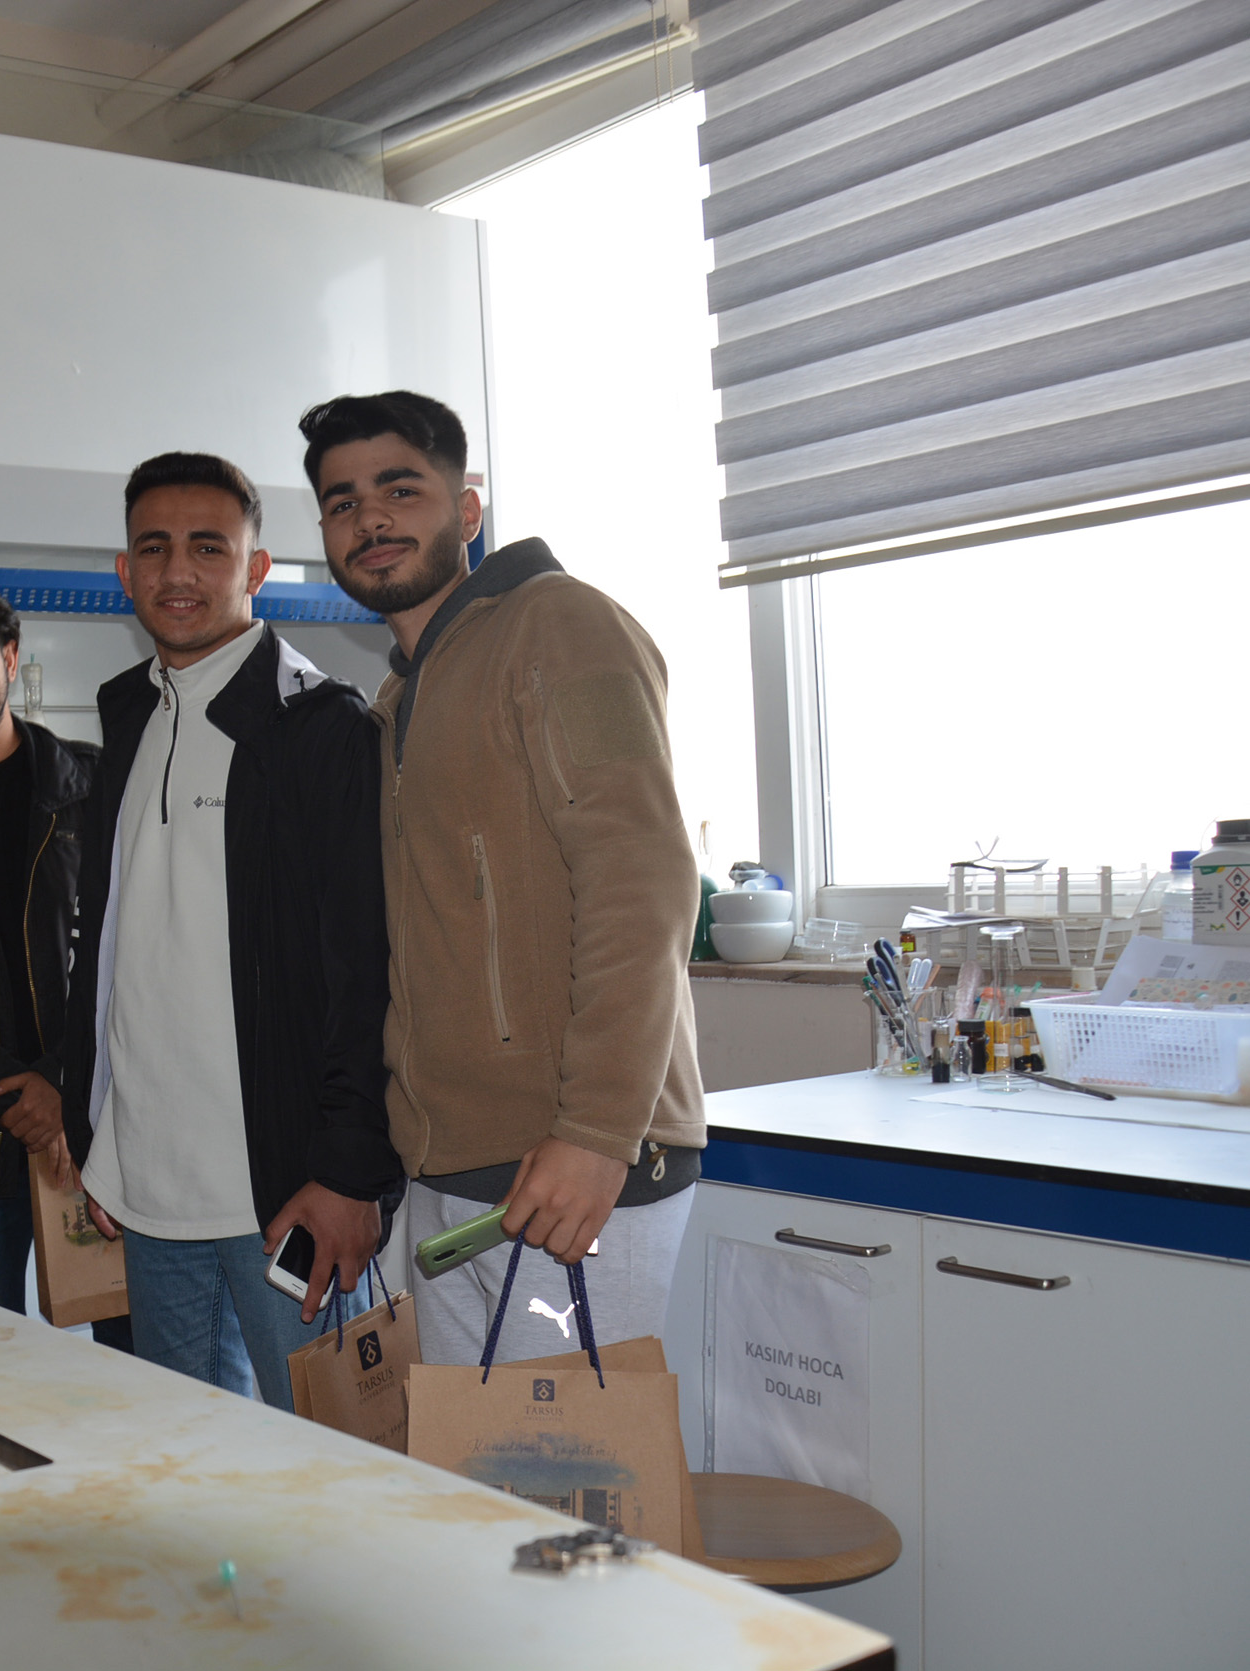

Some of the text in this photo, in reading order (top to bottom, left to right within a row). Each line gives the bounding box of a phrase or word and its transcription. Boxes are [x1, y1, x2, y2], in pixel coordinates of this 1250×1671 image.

[204, 796, 226, 807] Colu
[745, 1341, 844, 1380] KASIM HOCA
[356, 1366, 394, 1395] TARSUS
[765, 1377, 821, 1407] DOLABI
[524, 1405, 564, 1416] TARSUS
